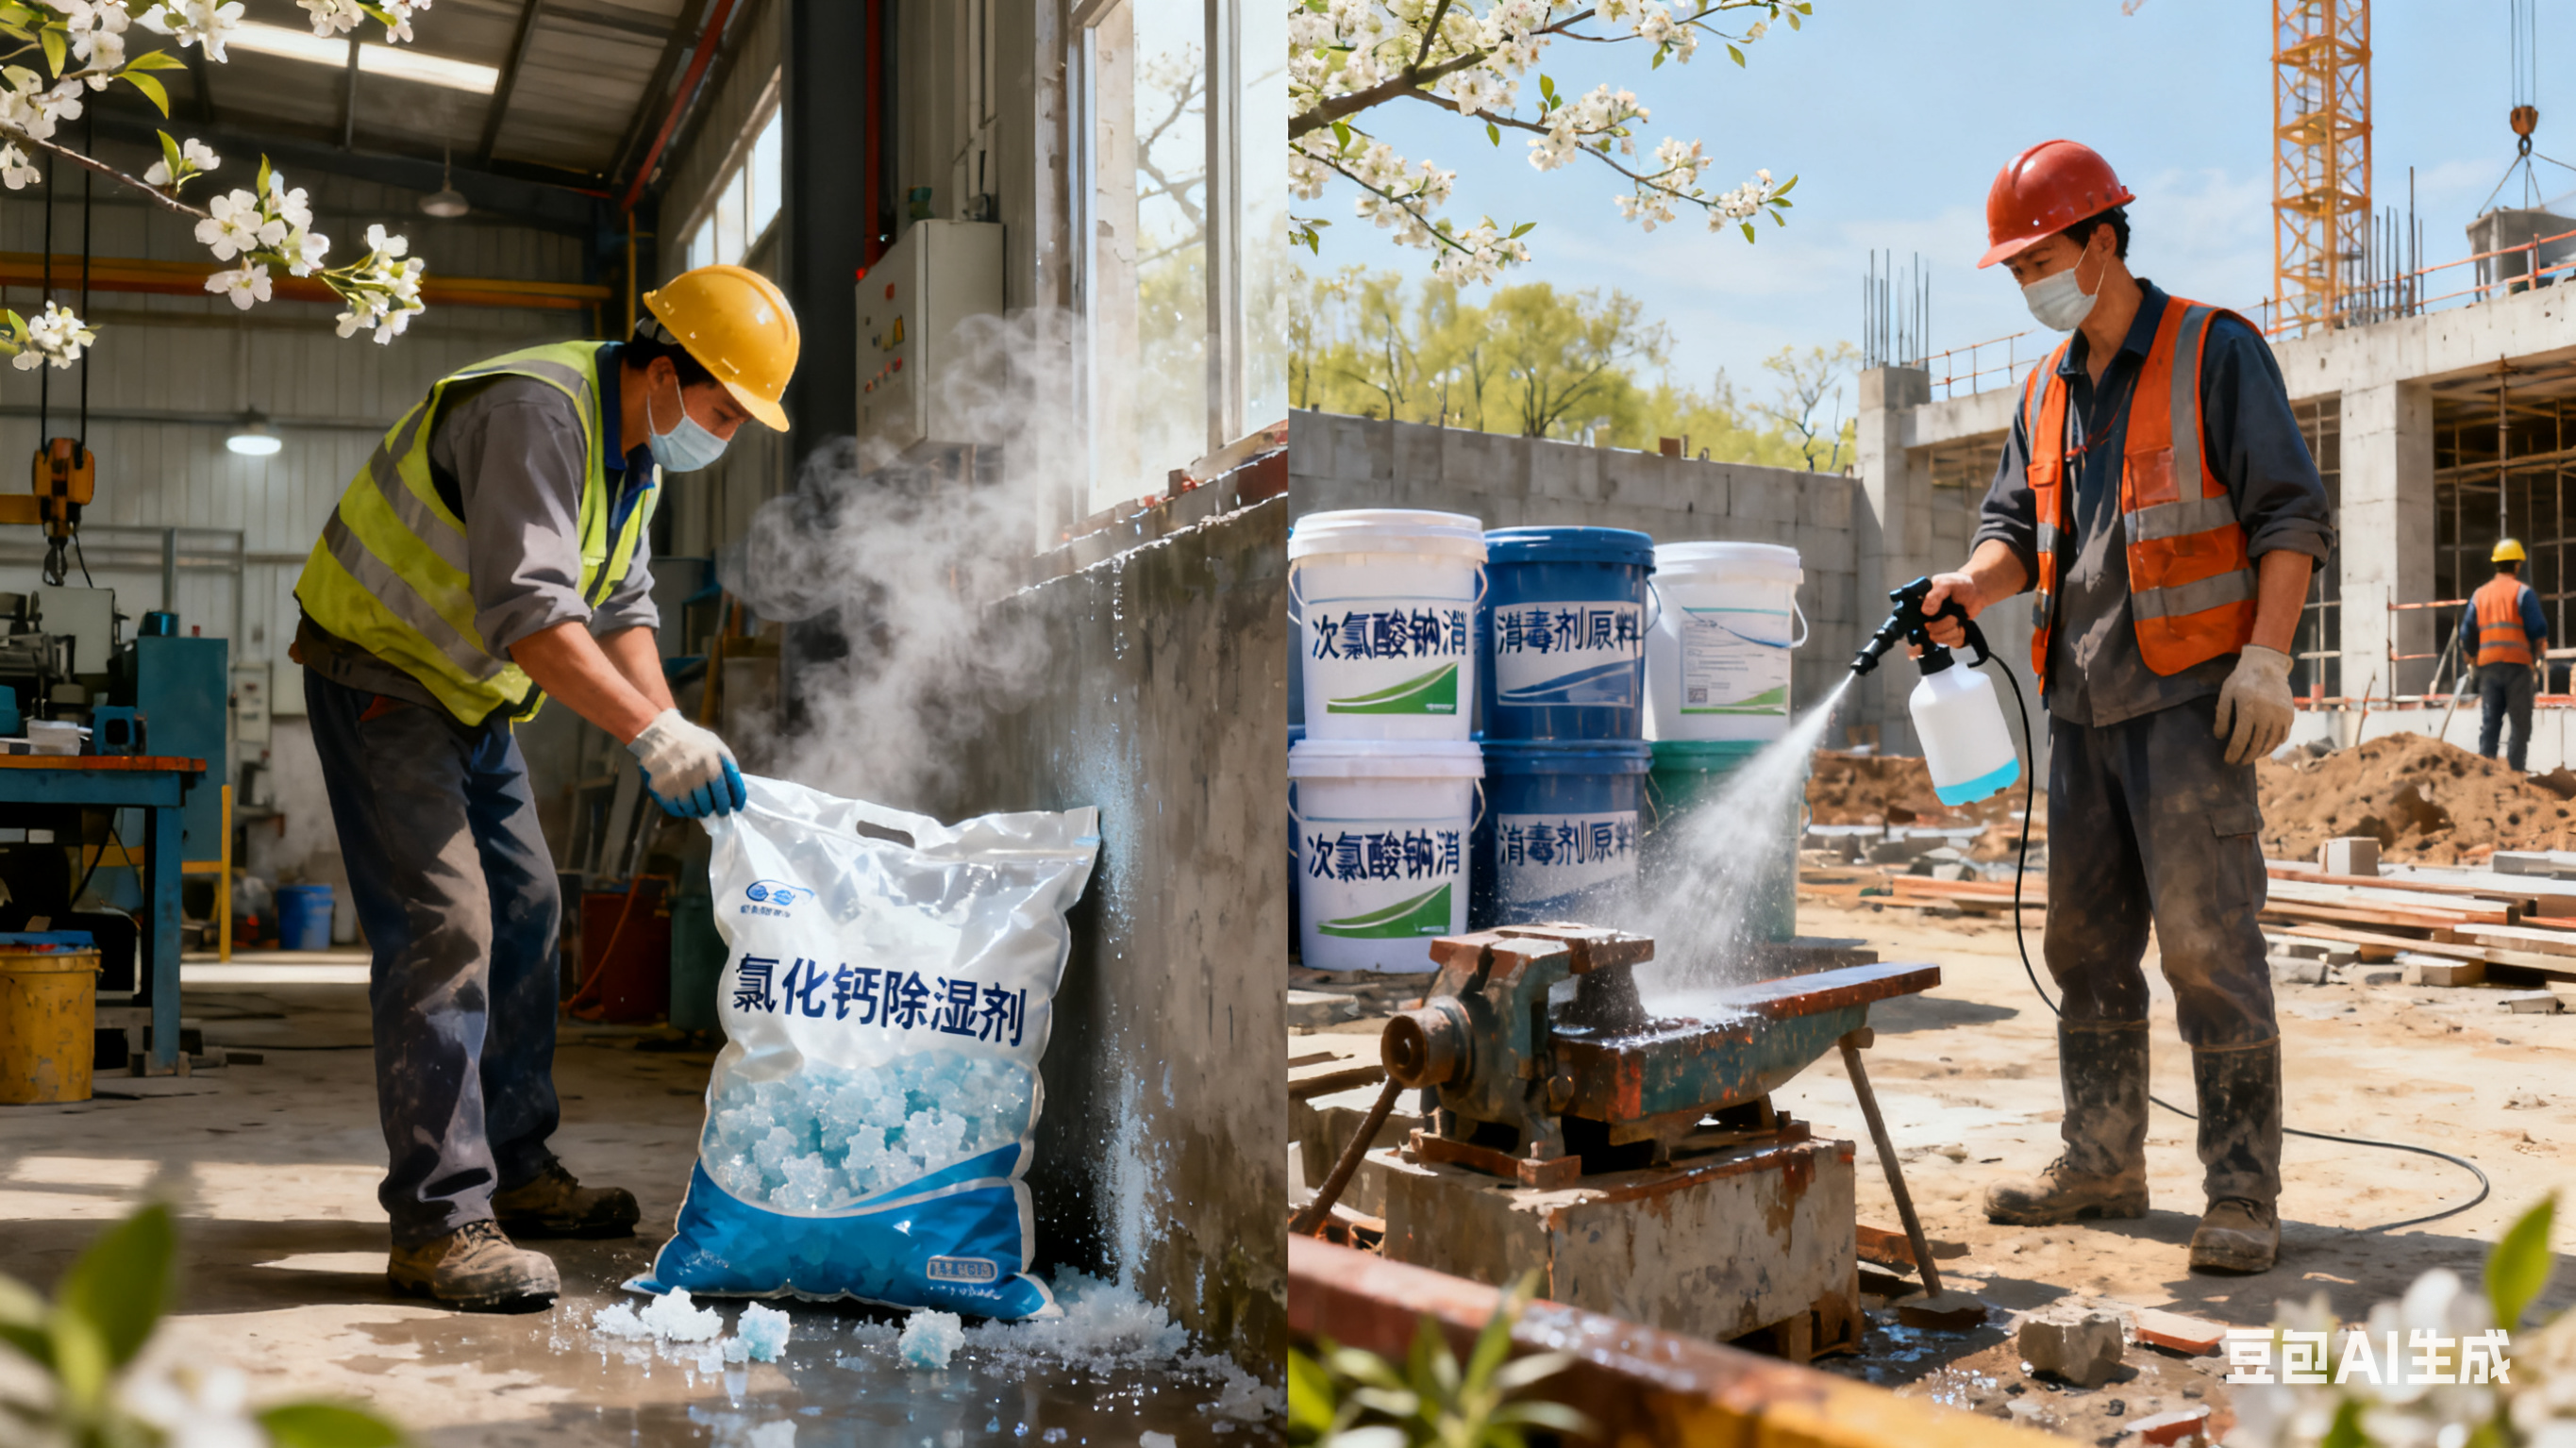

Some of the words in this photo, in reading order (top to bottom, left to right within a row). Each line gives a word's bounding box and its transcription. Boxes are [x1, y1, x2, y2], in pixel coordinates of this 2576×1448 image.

[1497, 606, 1643, 656] 消毒剂原料
[733, 953, 1027, 1047] 氯化钙除湿剂
